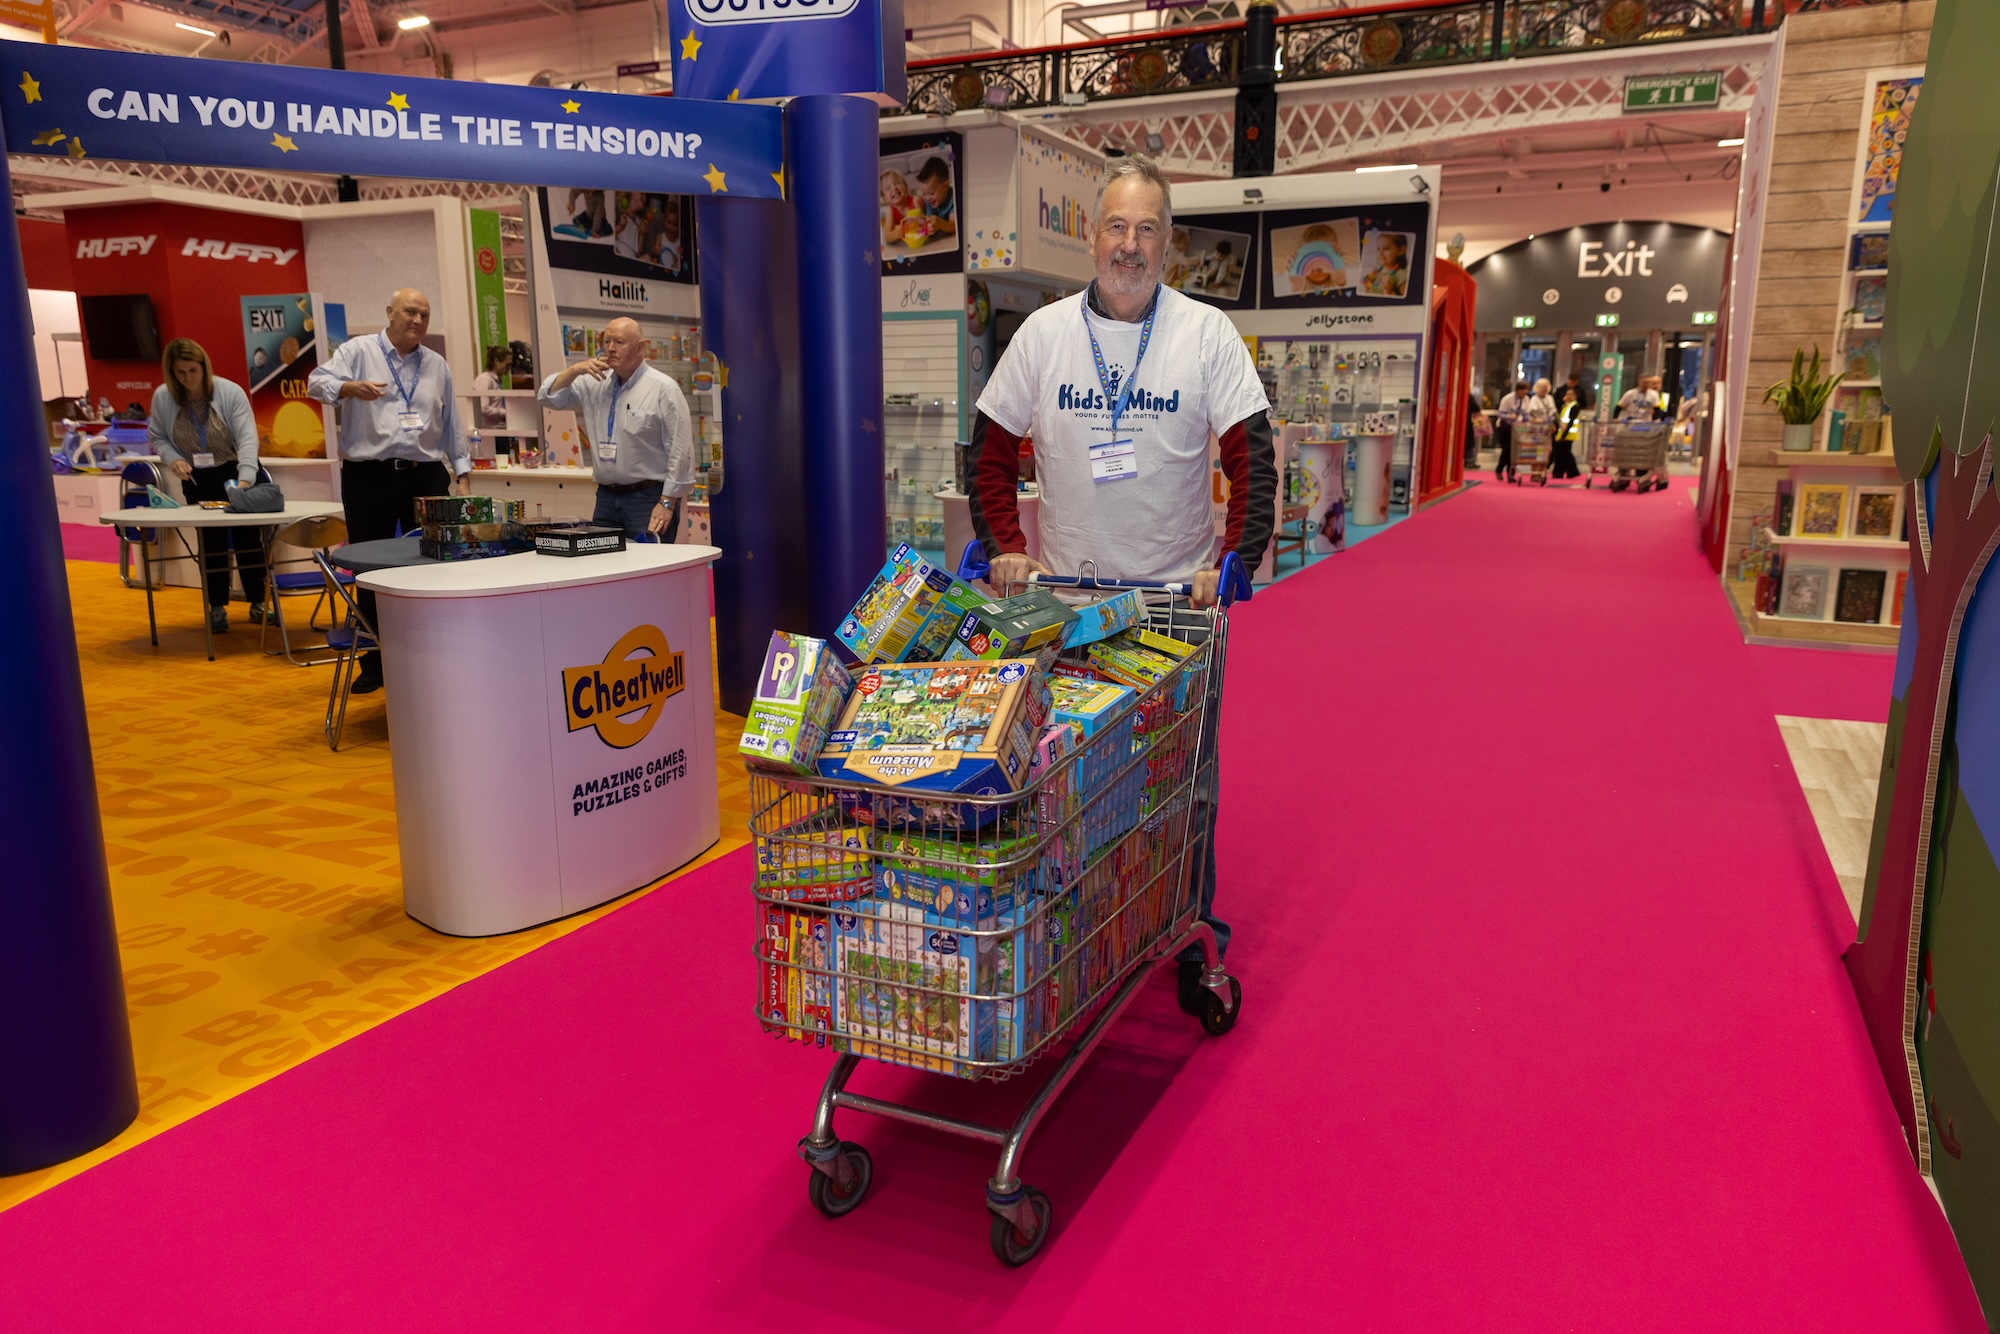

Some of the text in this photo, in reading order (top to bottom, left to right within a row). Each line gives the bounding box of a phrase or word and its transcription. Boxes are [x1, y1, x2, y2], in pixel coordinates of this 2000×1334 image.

[1630, 75, 1717, 91] EMERGENCY EXIT
[87, 87, 703, 159] CAN YOU HANDLE THE TENSION?
[1039, 187, 1087, 242] halilit
[76, 234, 157, 259] HUFFY
[181, 237, 298, 266] HUFFY
[1578, 240, 1655, 278] Exit
[251, 308, 284, 332] EXIT
[1306, 314, 1374, 328] jellystone
[1058, 384, 1103, 410] Kids
[1125, 388, 1179, 413] Mind
[535, 536, 570, 549] GUESSTIMATION
[576, 535, 619, 549] GUESSTIMATION
[868, 620, 888, 644] Outer
[885, 595, 906, 620] Space
[965, 615, 976, 631] 150
[572, 655, 683, 719] Cheatwell
[754, 711, 795, 726] Alphabet
[759, 722, 784, 734] Giant
[744, 737, 756, 745] 26
[831, 731, 844, 741] 150
[868, 756, 935, 769] Museum
[878, 766, 916, 777] the At
[572, 765, 643, 799] AMAZING
[573, 763, 688, 816] PUZZLES & GIFTS!
